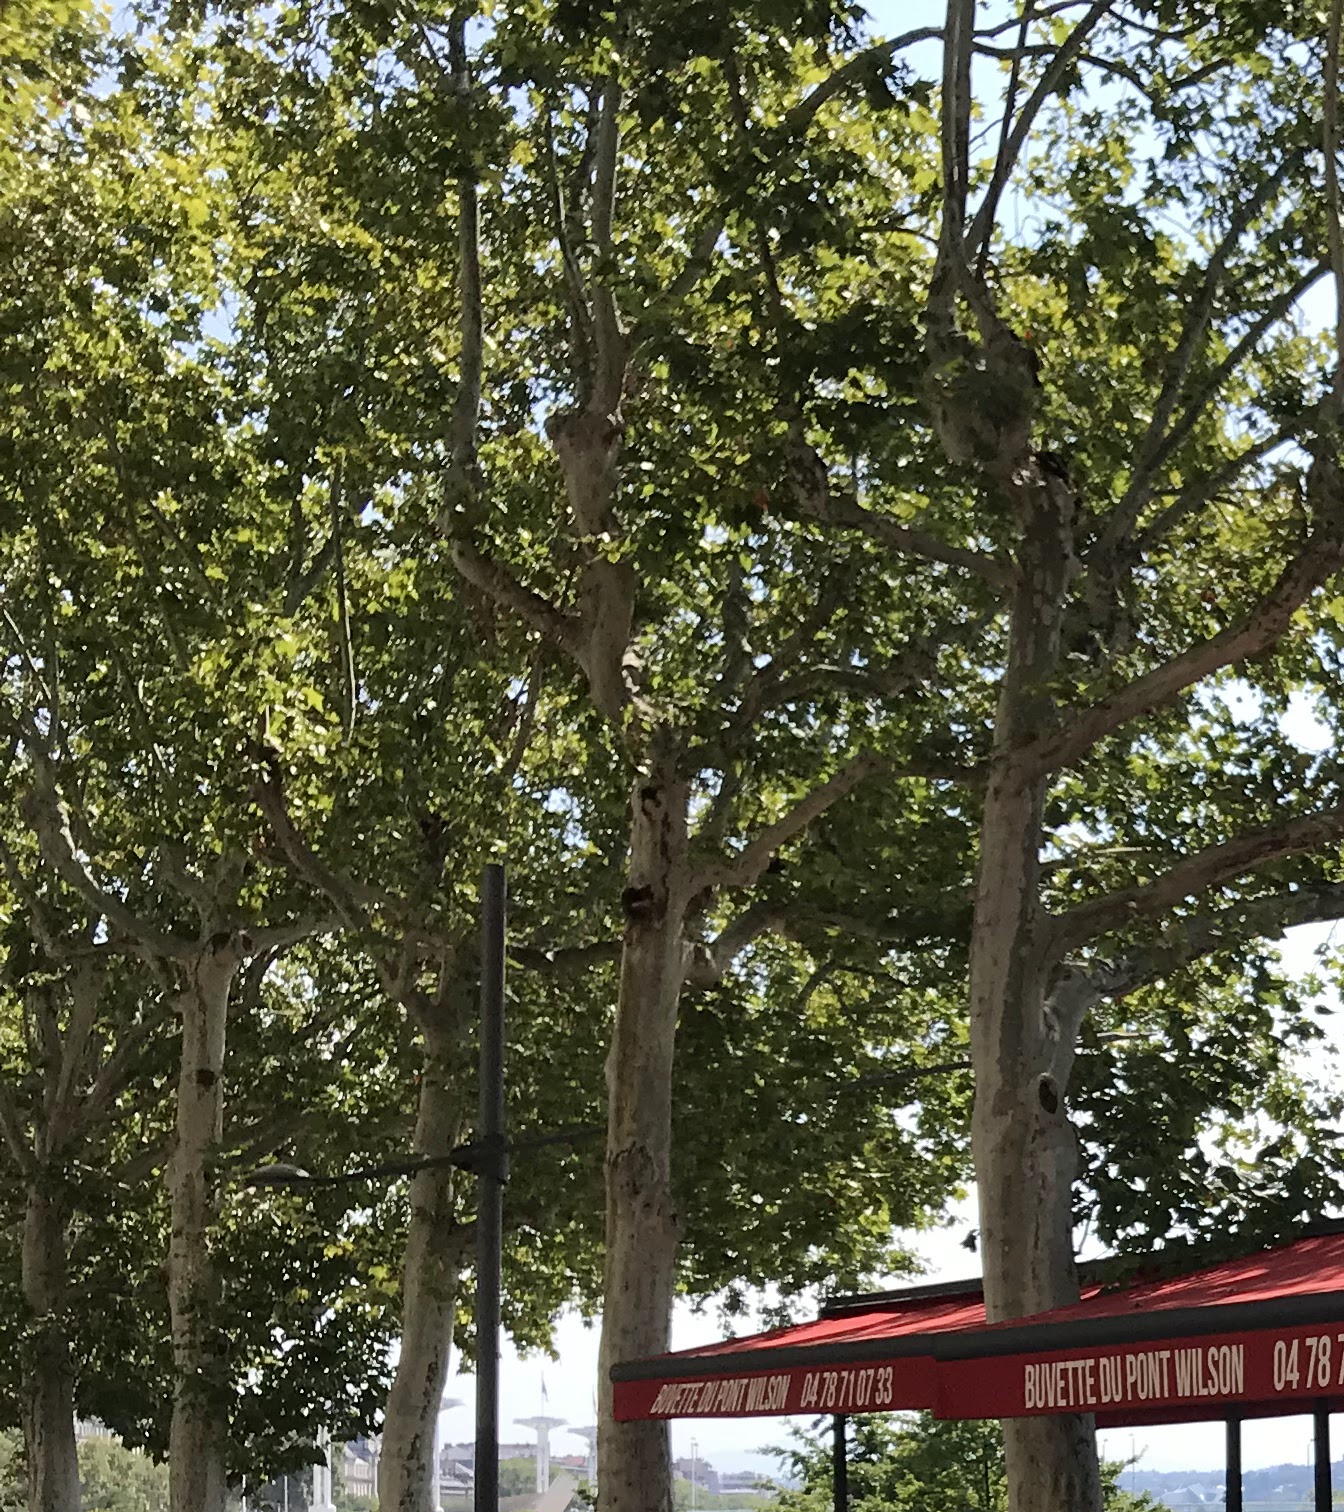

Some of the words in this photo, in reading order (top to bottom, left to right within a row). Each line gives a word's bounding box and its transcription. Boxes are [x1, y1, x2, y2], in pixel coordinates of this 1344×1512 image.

[650, 1383, 703, 1414] BUVETTE
[700, 1382, 719, 1413] DU
[716, 1378, 749, 1412] PONT
[746, 1374, 791, 1412] WILSON
[800, 1373, 820, 1408] 04
[822, 1371, 837, 1407] 78
[839, 1370, 854, 1407] 71
[856, 1368, 875, 1406] 07
[875, 1366, 893, 1404] 33
[1025, 1358, 1096, 1409] BUVETTE
[1100, 1355, 1122, 1403] DU
[1127, 1350, 1171, 1400] PONT
[1174, 1343, 1244, 1397] WILSON
[1273, 1340, 1300, 1392] 04
[1305, 1335, 1332, 1388] 78
